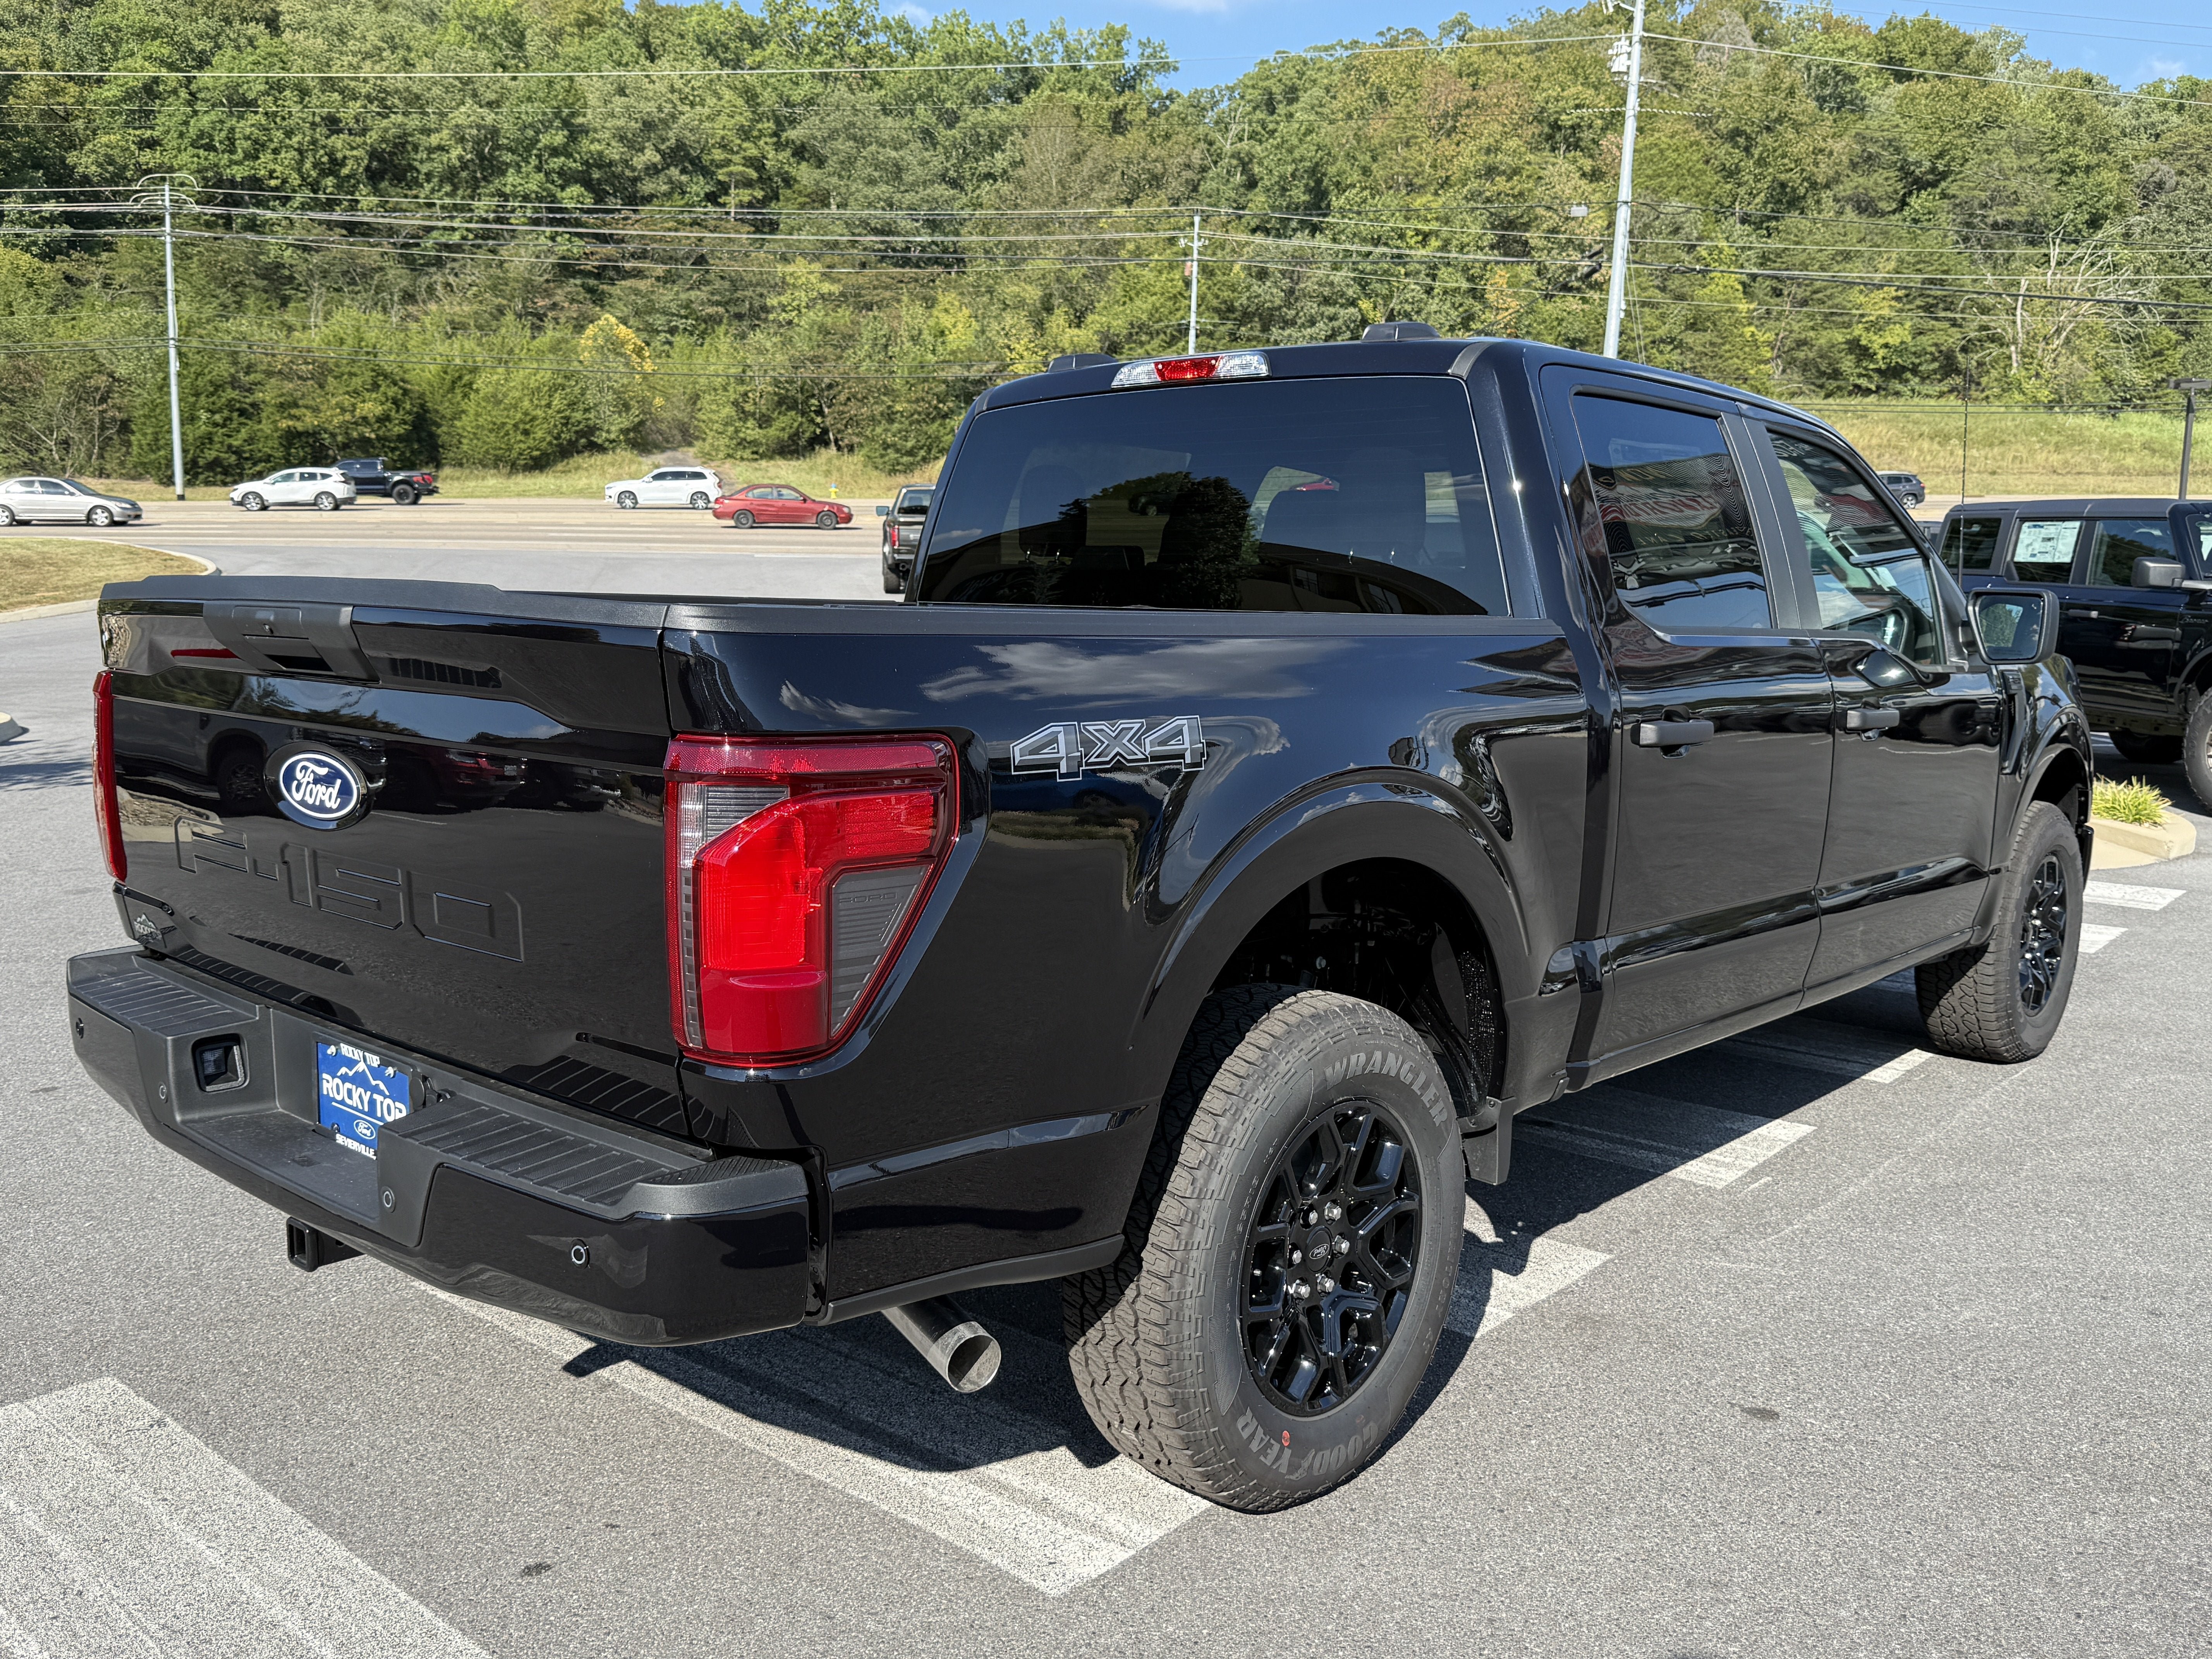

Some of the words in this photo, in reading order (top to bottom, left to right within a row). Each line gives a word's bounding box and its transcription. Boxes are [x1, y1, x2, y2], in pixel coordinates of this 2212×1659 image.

[292, 761, 341, 809] Ford
[175, 814, 524, 963] F-150
[838, 892, 898, 906] FORD
[340, 1043, 363, 1061] ROCKY
[364, 1052, 380, 1068] TOP
[322, 1073, 371, 1112] ROCKY
[373, 1094, 407, 1122] TOP
[1323, 1051, 1447, 1128] WRANGLER
[336, 1133, 376, 1160] SEVIERVILLE
[358, 1122, 371, 1137] Ford
